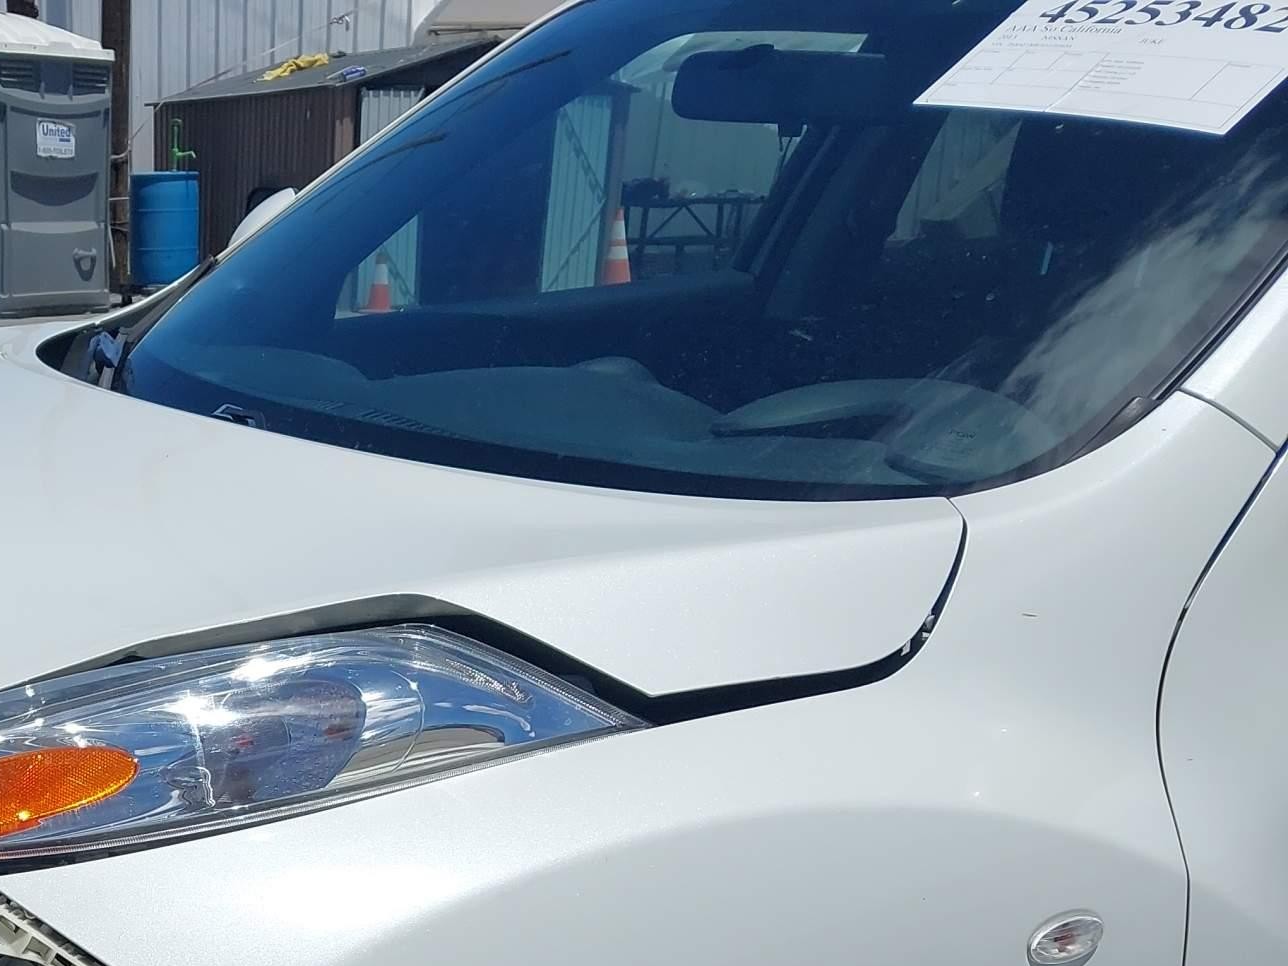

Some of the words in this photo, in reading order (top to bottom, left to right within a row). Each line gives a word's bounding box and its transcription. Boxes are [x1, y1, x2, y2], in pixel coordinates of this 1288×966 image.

[1038, 0, 1288, 33] 45253482
[1005, 24, 1040, 33] AAA
[1042, 25, 1060, 33] So
[1060, 24, 1122, 35] California
[41, 123, 71, 138] United
